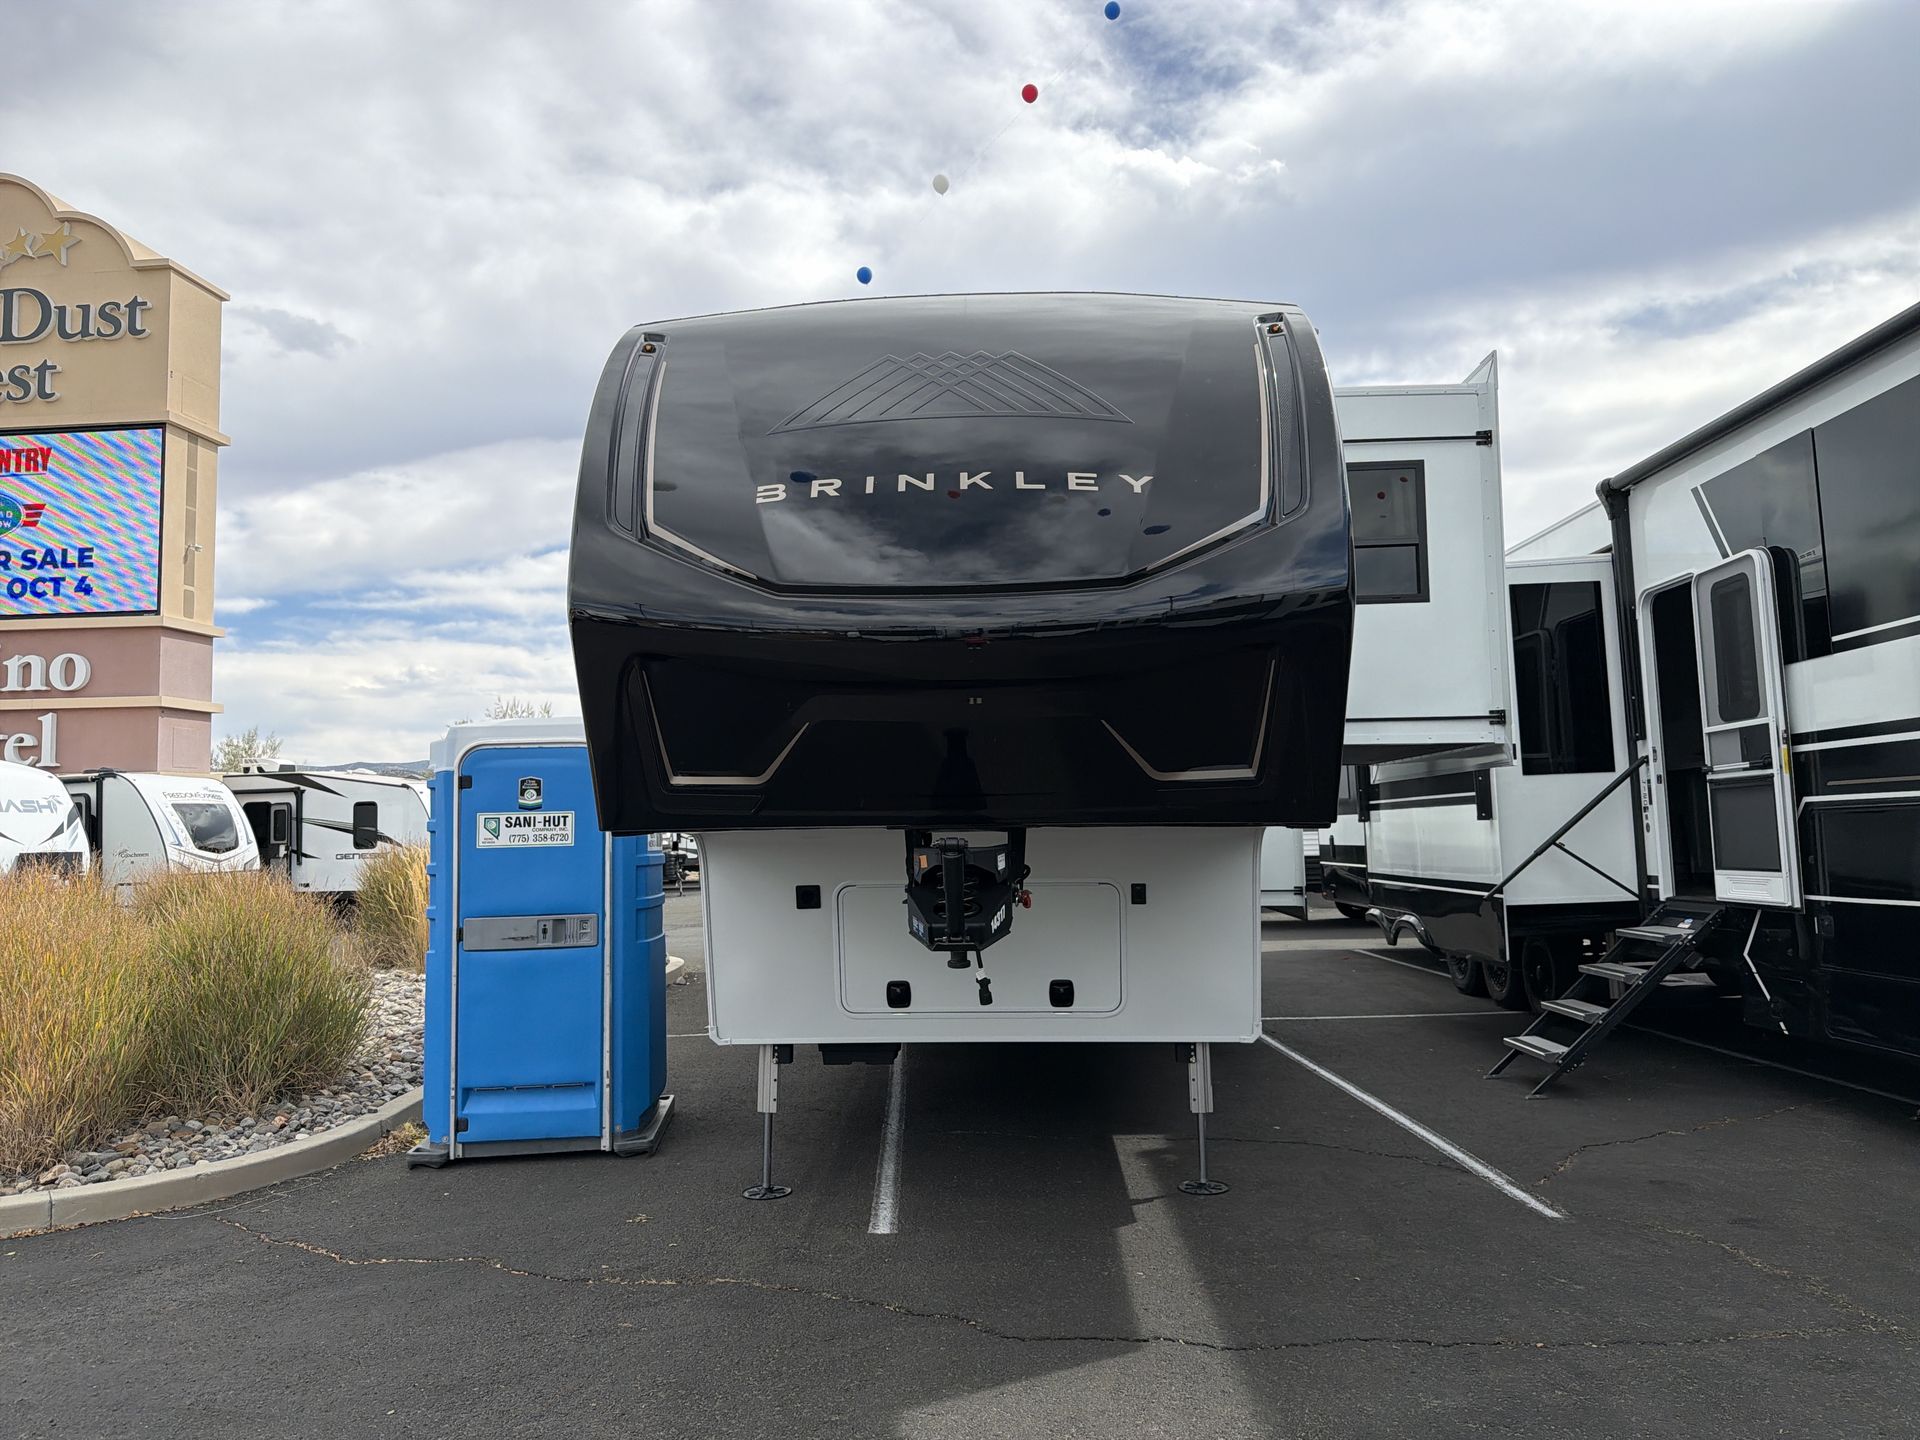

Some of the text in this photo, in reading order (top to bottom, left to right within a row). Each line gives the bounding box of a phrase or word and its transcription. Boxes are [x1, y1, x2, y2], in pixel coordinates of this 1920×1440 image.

[0, 288, 150, 343] Dust
[756, 471, 1154, 504] BRINKLEY
[20, 547, 95, 571] SALE
[6, 575, 94, 599] OCT 4
[0, 653, 91, 692] no
[0, 712, 61, 767] el
[505, 815, 569, 828] SANI-HUT
[508, 833, 569, 843] (775) 358-6720
